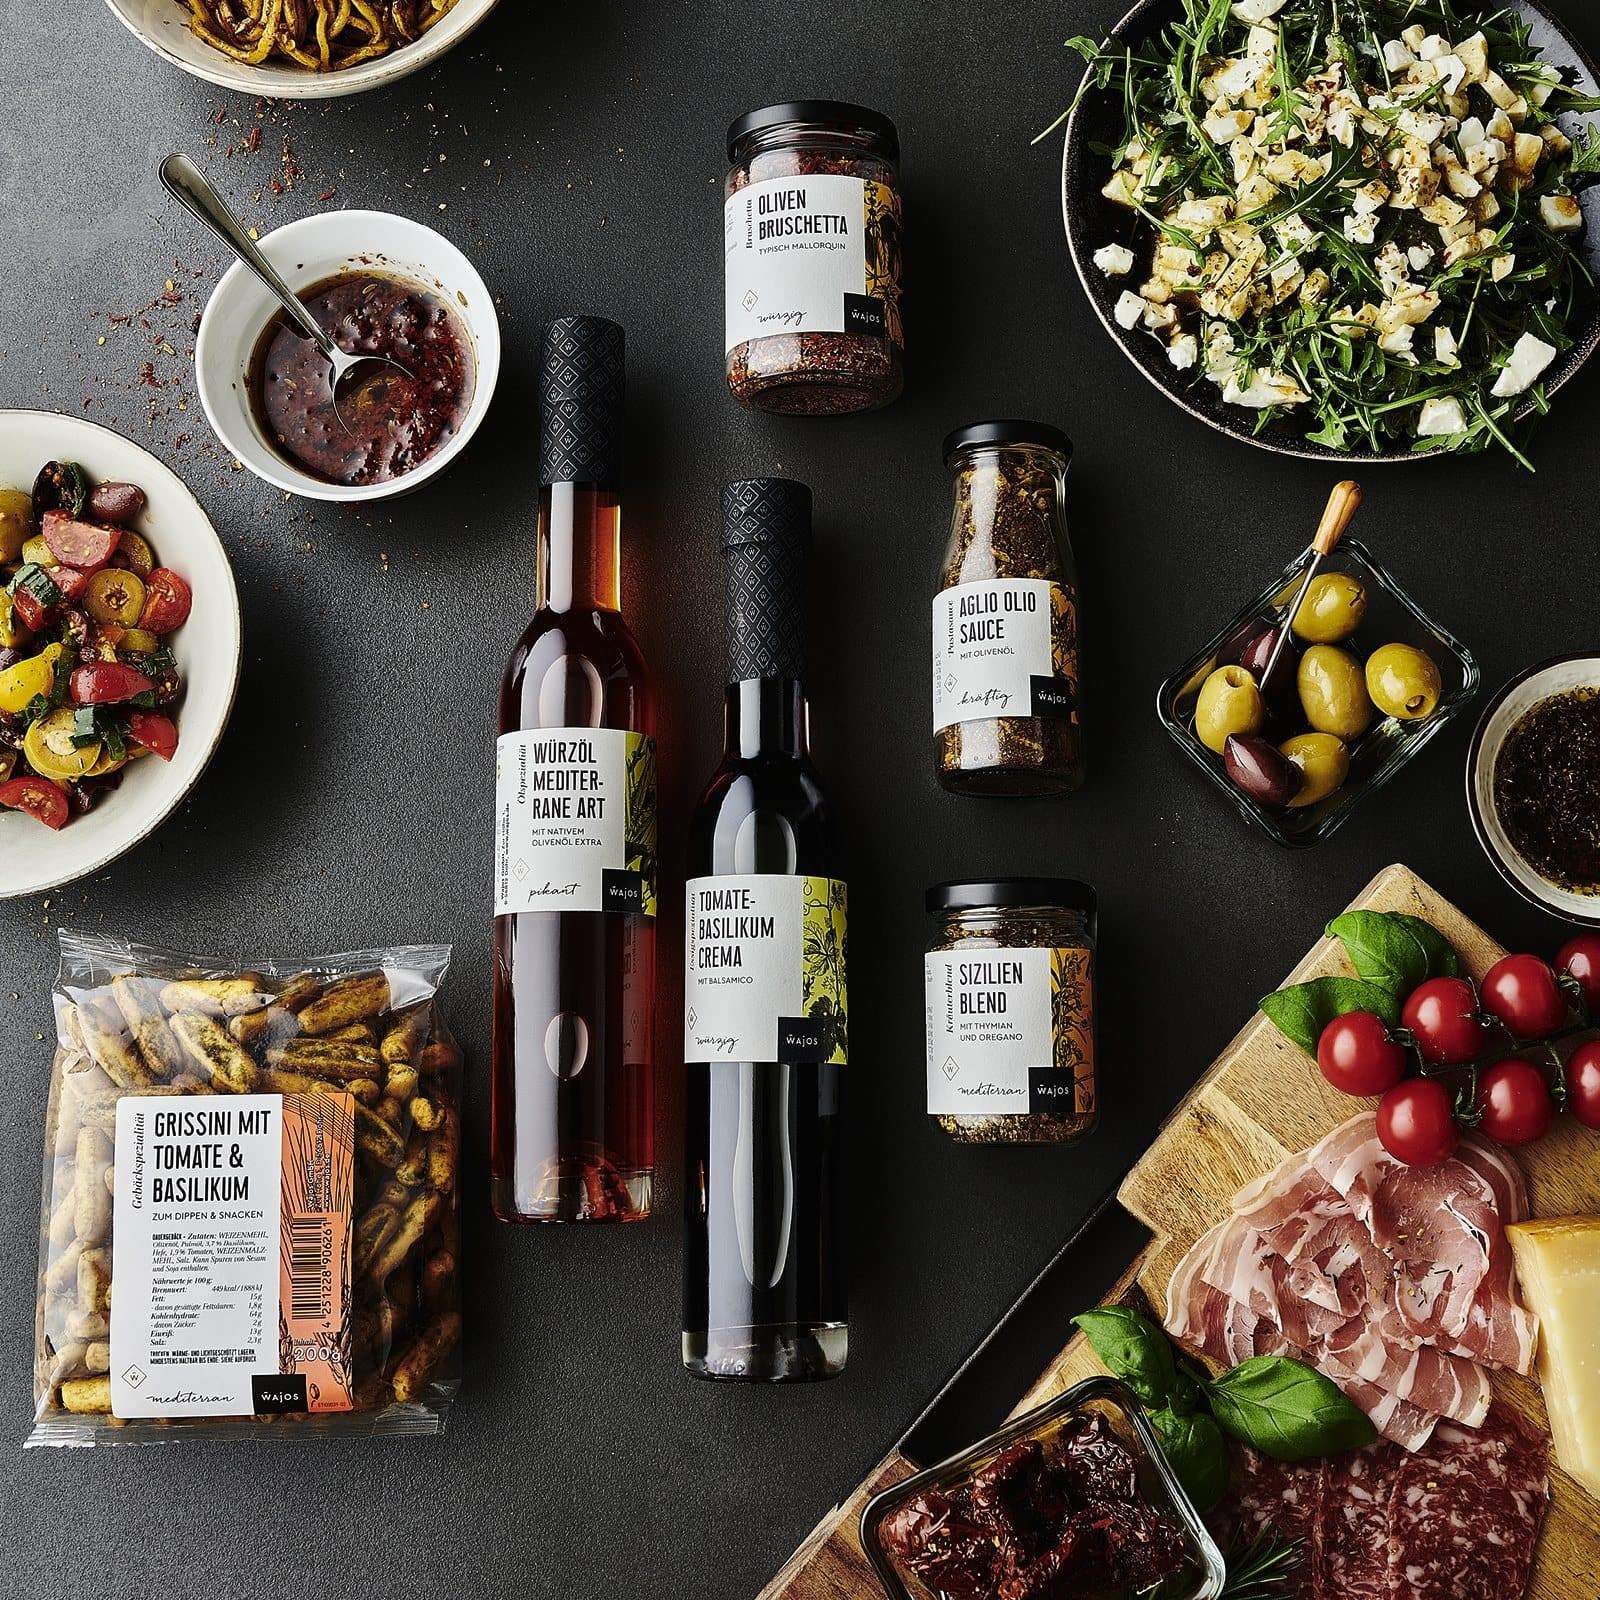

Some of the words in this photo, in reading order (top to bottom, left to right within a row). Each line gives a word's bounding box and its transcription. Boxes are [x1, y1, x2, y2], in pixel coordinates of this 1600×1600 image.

[759, 189, 806, 215] OLIVEN
[759, 215, 848, 240] BRUSCHETTA
[759, 244, 790, 255] TYPISCH
[792, 242, 846, 251] MALLORQUIN
[757, 310, 807, 326] würzig
[960, 592, 998, 617] AGLIO
[1004, 592, 1036, 613] OLIO
[960, 619, 1004, 644] SAUCE
[960, 652, 972, 660] MIT
[974, 646, 1015, 658] OLIVENÖL
[957, 689, 1013, 709] kräftig
[534, 739, 597, 764] WÜRZÖL
[534, 770, 603, 791] MEDITER-
[533, 798, 571, 820] RANE
[576, 798, 606, 819] ART
[532, 838, 573, 847] OLIVENÖL
[528, 882, 580, 903] pikant
[700, 889, 755, 912] TOMATE-
[700, 917, 774, 940] BASILIKUM
[699, 946, 742, 968] CREMA
[960, 962, 1023, 985] SIZILIEN
[945, 964, 954, 1033] Kräuterblend
[960, 992, 1007, 1014] BLEND
[975, 1022, 1013, 1030] THYMIAN
[696, 1035, 739, 1053] würzig
[957, 1082, 1026, 1096] mediterran
[155, 1112, 231, 1137] GRISSINI
[239, 1110, 271, 1135] MIT
[132, 1112, 145, 1209] Gebäckspezialität
[153, 1144, 223, 1170] TOMATE
[229, 1143, 244, 1168] &
[153, 1176, 249, 1202] BASILIKUM
[175, 1212, 208, 1220] DIPPEN
[219, 1211, 263, 1219] SNACKEN
[322, 1221, 332, 1264] 906261
[322, 1270, 331, 1314] 251228
[146, 1390, 235, 1404] mediterran
